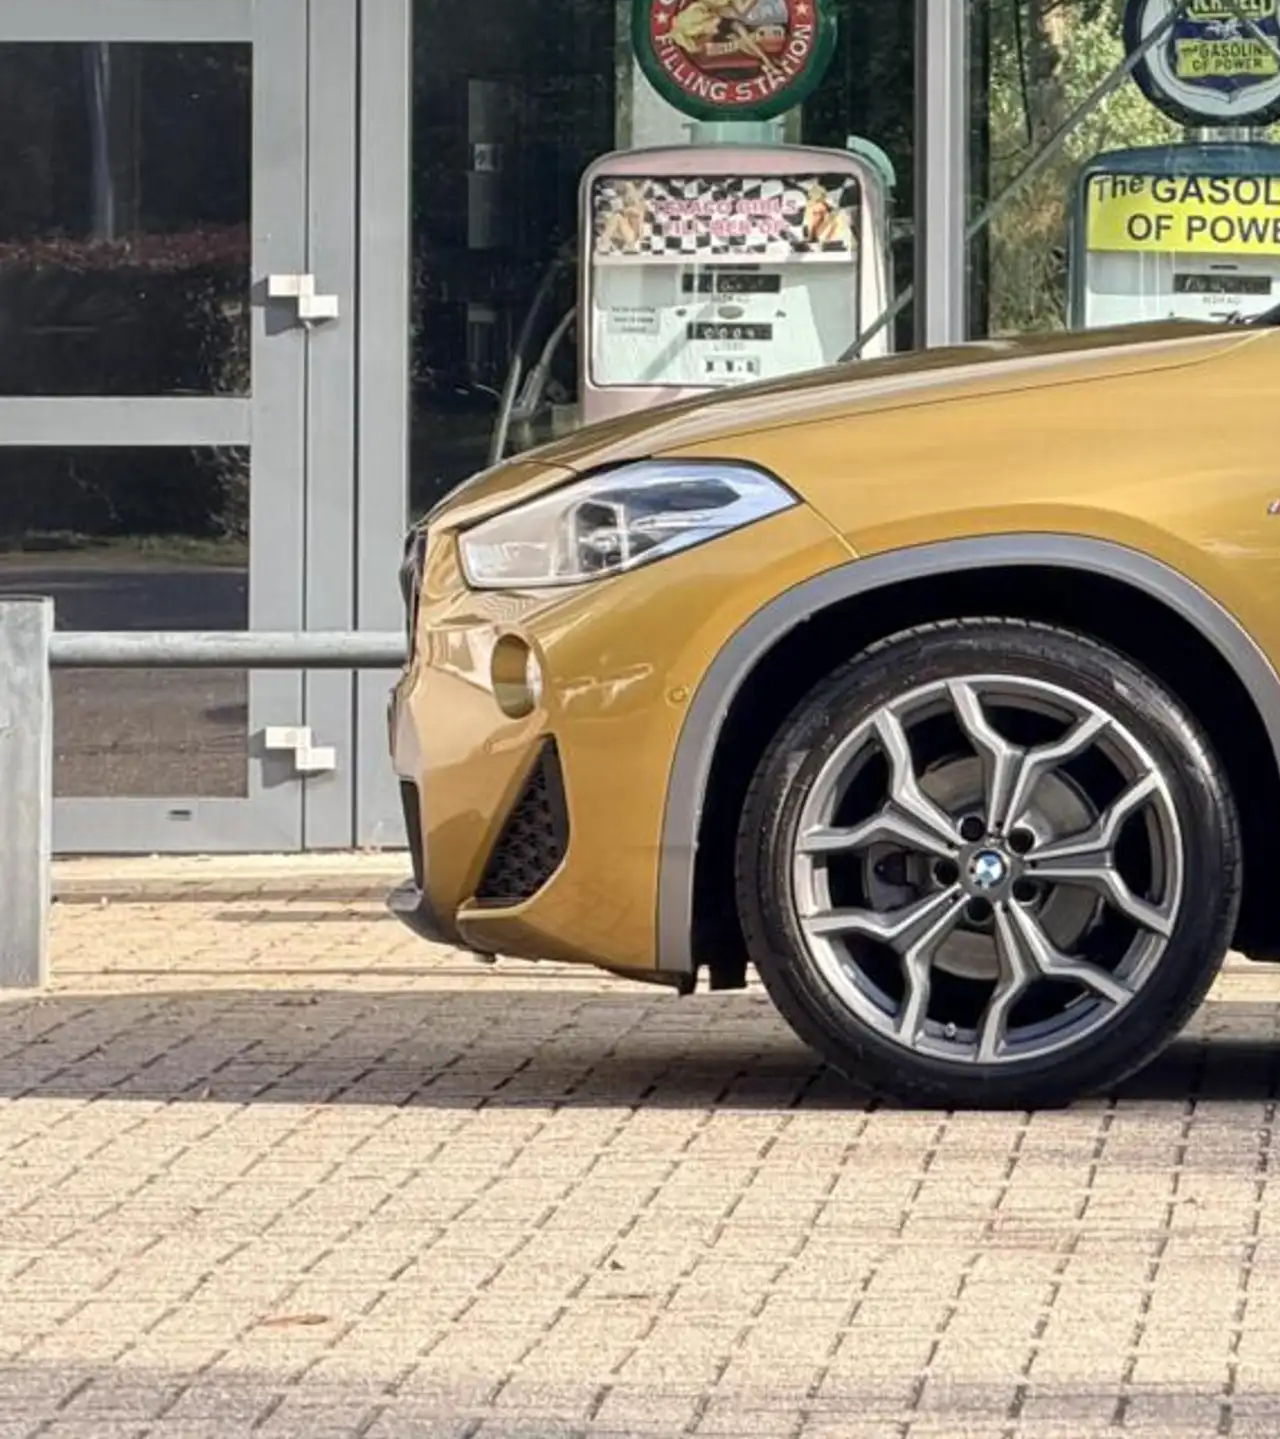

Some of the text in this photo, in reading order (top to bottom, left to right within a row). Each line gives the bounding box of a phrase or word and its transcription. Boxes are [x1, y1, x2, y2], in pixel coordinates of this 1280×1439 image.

[655, 23, 812, 101] FILLING STATION
[1093, 174, 1145, 203] The
[1126, 213, 1174, 241] OF
